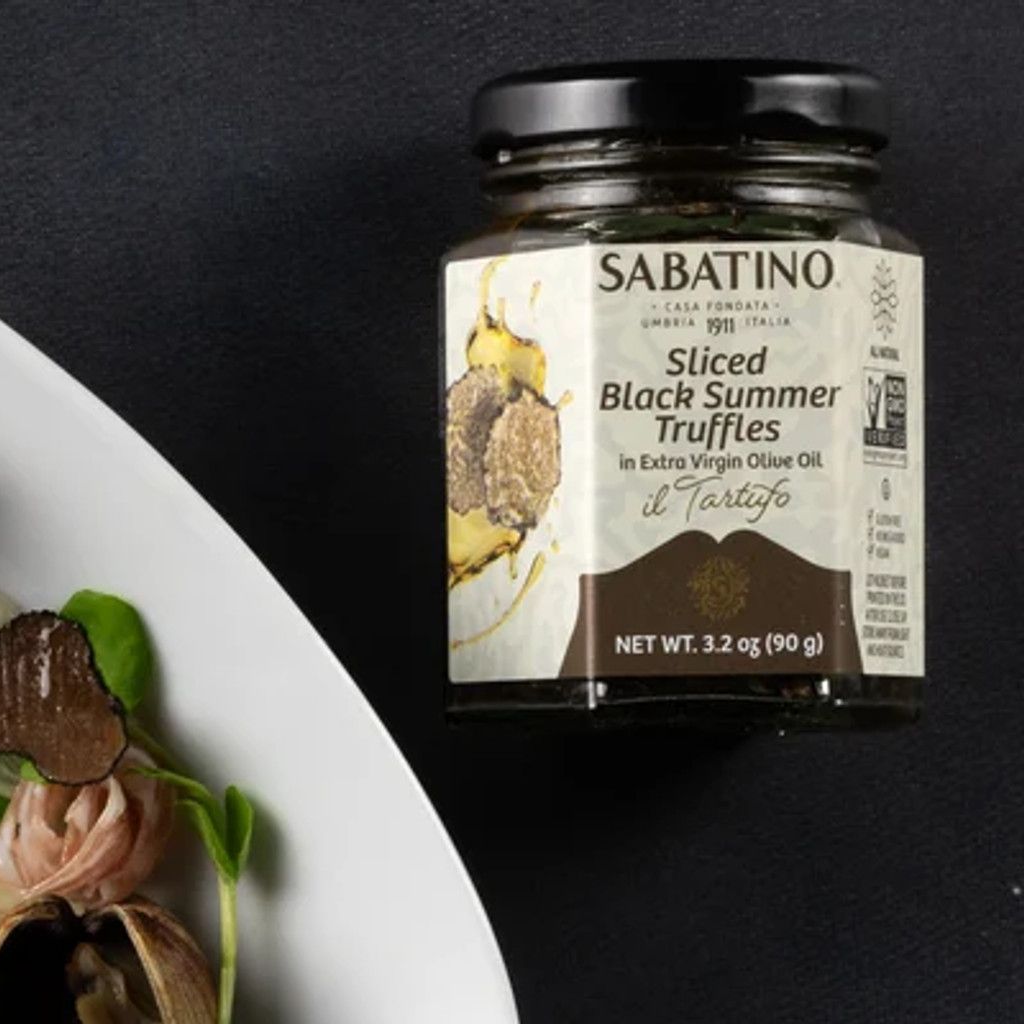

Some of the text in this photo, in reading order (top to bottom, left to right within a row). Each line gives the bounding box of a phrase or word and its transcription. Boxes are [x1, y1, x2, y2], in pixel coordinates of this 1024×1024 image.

[598, 249, 834, 292] SABATINO
[665, 302, 700, 312] CASA
[640, 317, 791, 336] UMBRIA 1911 ITALIA
[666, 346, 768, 376] Sliced
[599, 381, 842, 411] Black Summer
[655, 412, 781, 450] Truffles
[619, 451, 824, 474] in Extra Virgin Olive Oil
[642, 474, 792, 524] il Tartufo
[615, 635, 656, 654] NET
[661, 635, 698, 653] WT.
[702, 635, 733, 653] 3.2
[765, 632, 798, 656] (90
[803, 632, 824, 658] g)
